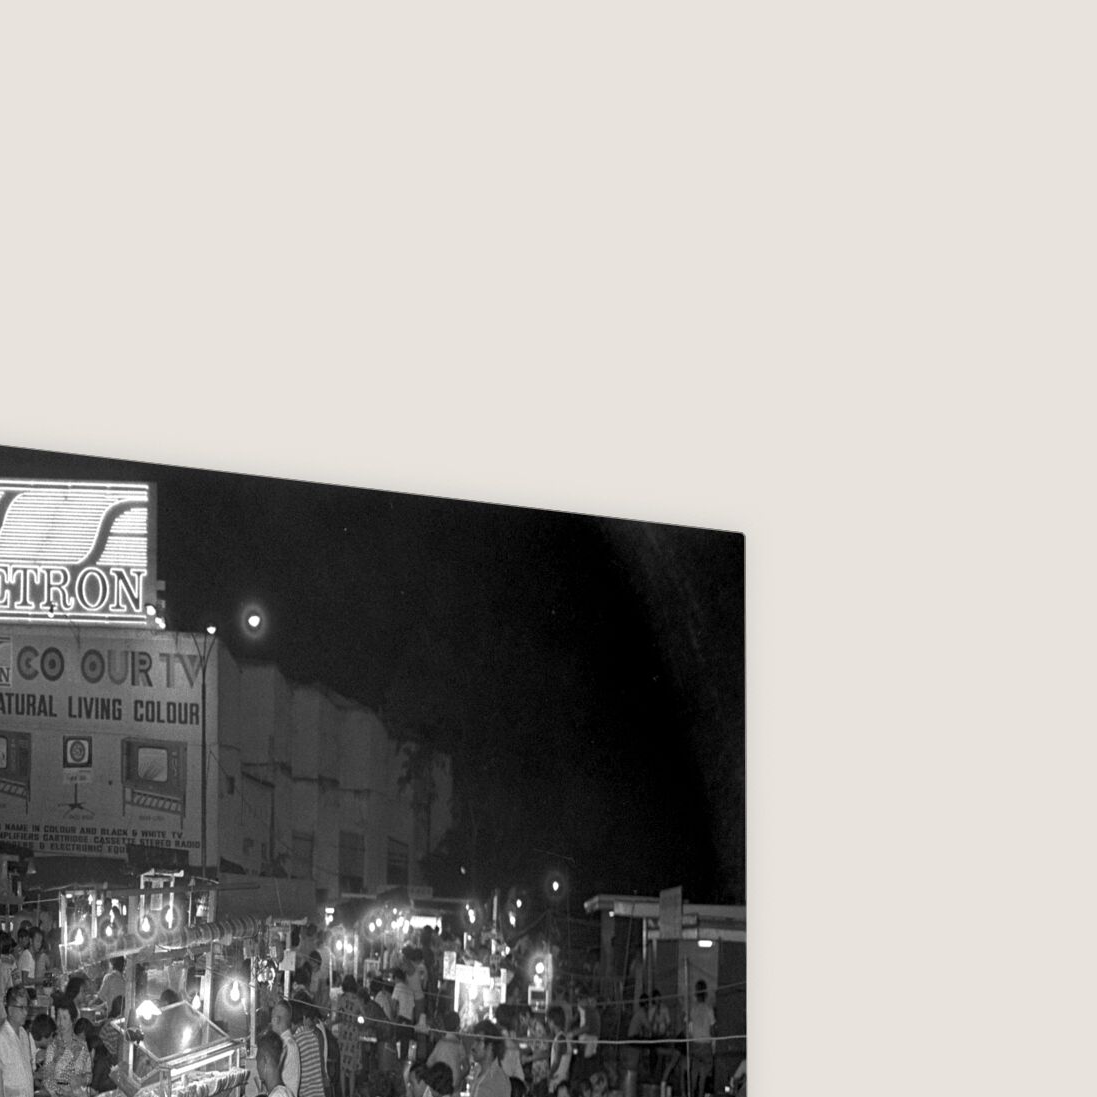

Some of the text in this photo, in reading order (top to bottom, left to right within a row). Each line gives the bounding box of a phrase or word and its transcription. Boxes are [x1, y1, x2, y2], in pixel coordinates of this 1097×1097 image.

[159, 652, 203, 689] TV
[68, 696, 122, 720] LIVING
[134, 700, 200, 725] COLOUR
[5, 823, 28, 832] NAME
[32, 824, 40, 833] IN
[44, 825, 76, 834] COLOUR
[79, 826, 97, 835] AND
[101, 828, 128, 837] BLACK
[141, 830, 166, 839] WHITE
[171, 832, 183, 840] TV
[51, 842, 103, 853] ELECTRONIC
[174, 840, 200, 849] RADIO
